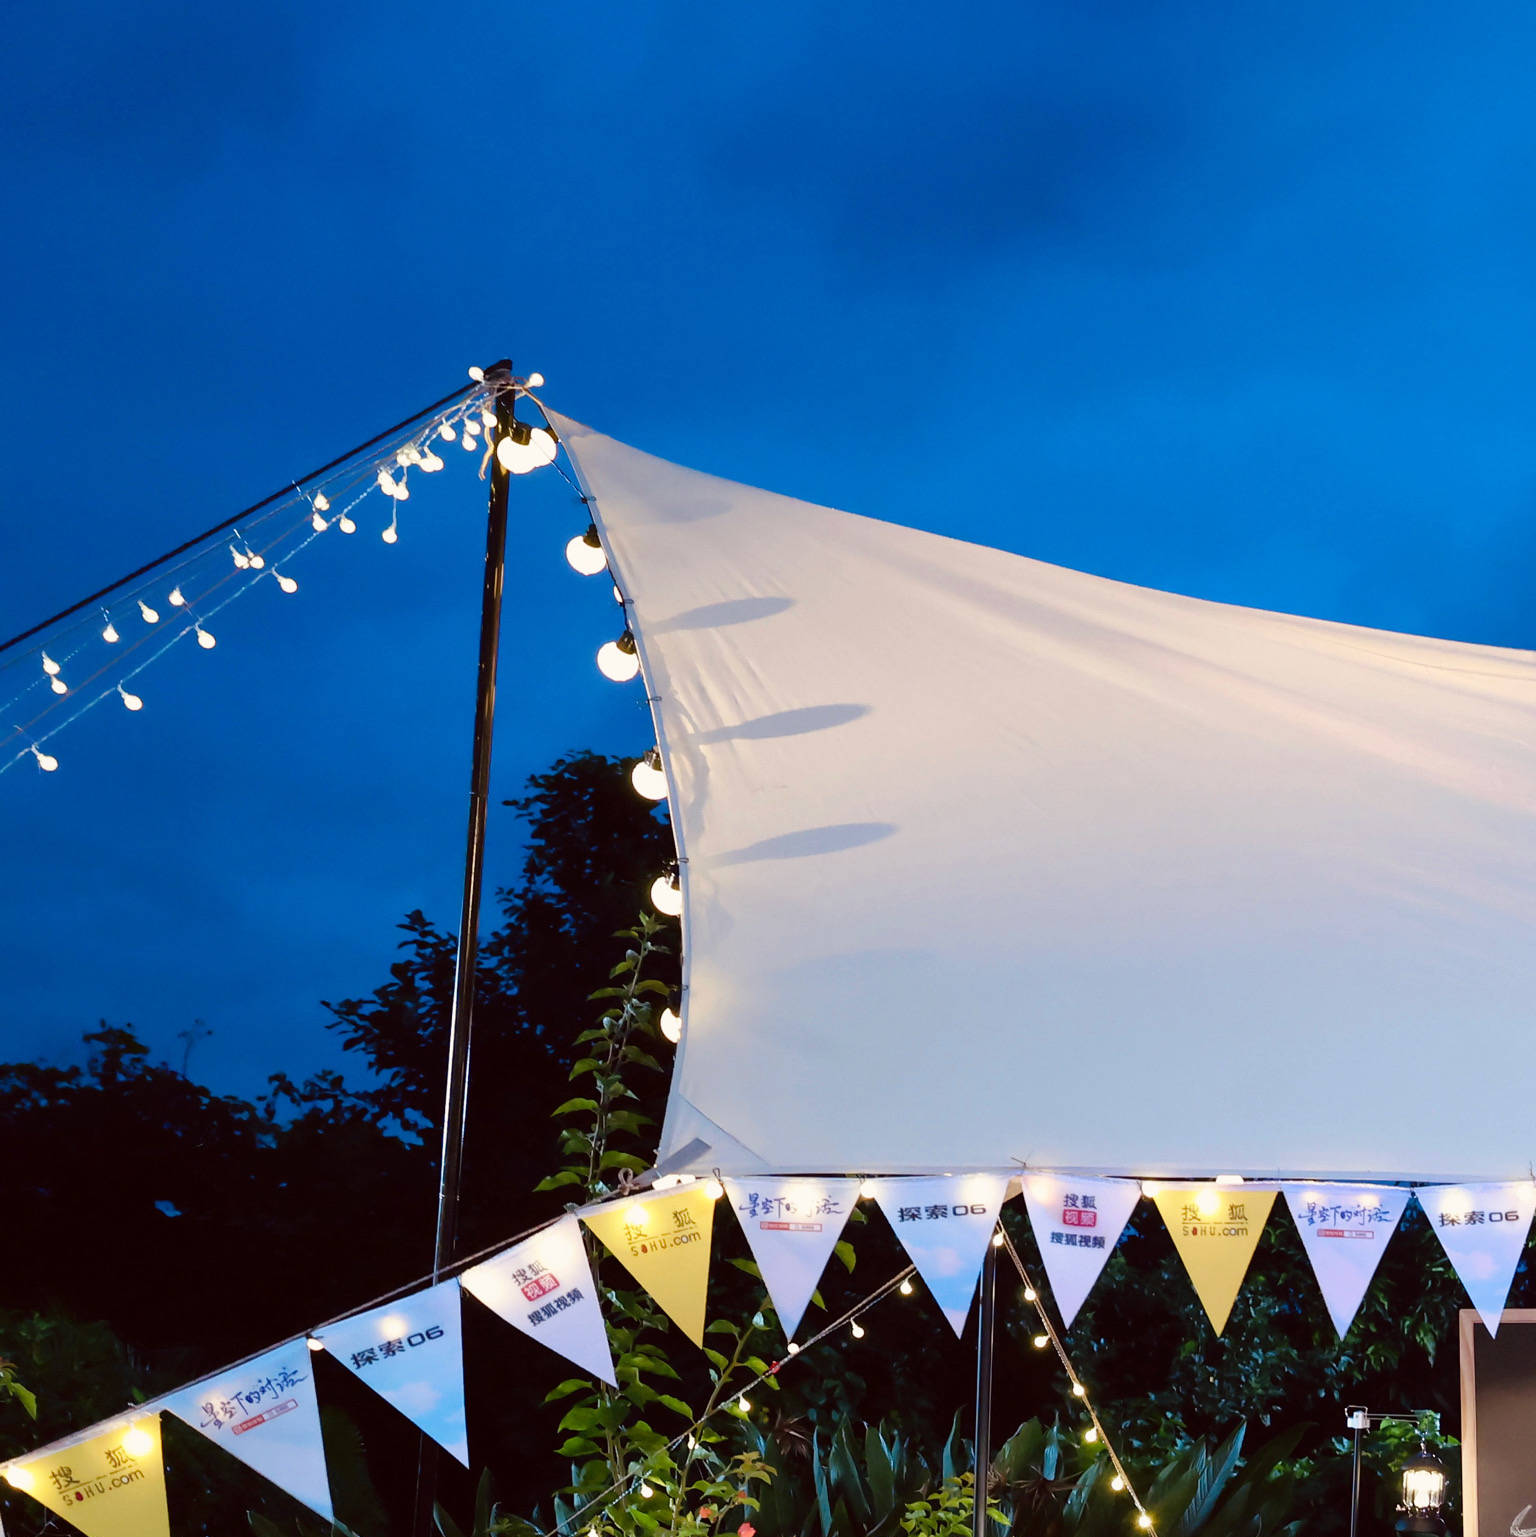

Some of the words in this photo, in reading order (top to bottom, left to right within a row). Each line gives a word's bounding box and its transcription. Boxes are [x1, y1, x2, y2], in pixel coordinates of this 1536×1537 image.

[739, 1193, 844, 1219] 星空下的话
[898, 1204, 986, 1222] 探索06
[1439, 1210, 1519, 1227] 探索06
[1051, 1232, 1105, 1249] 搜狐视频
[528, 1288, 584, 1326] 搜狐视频
[351, 1325, 444, 1370] 探索06
